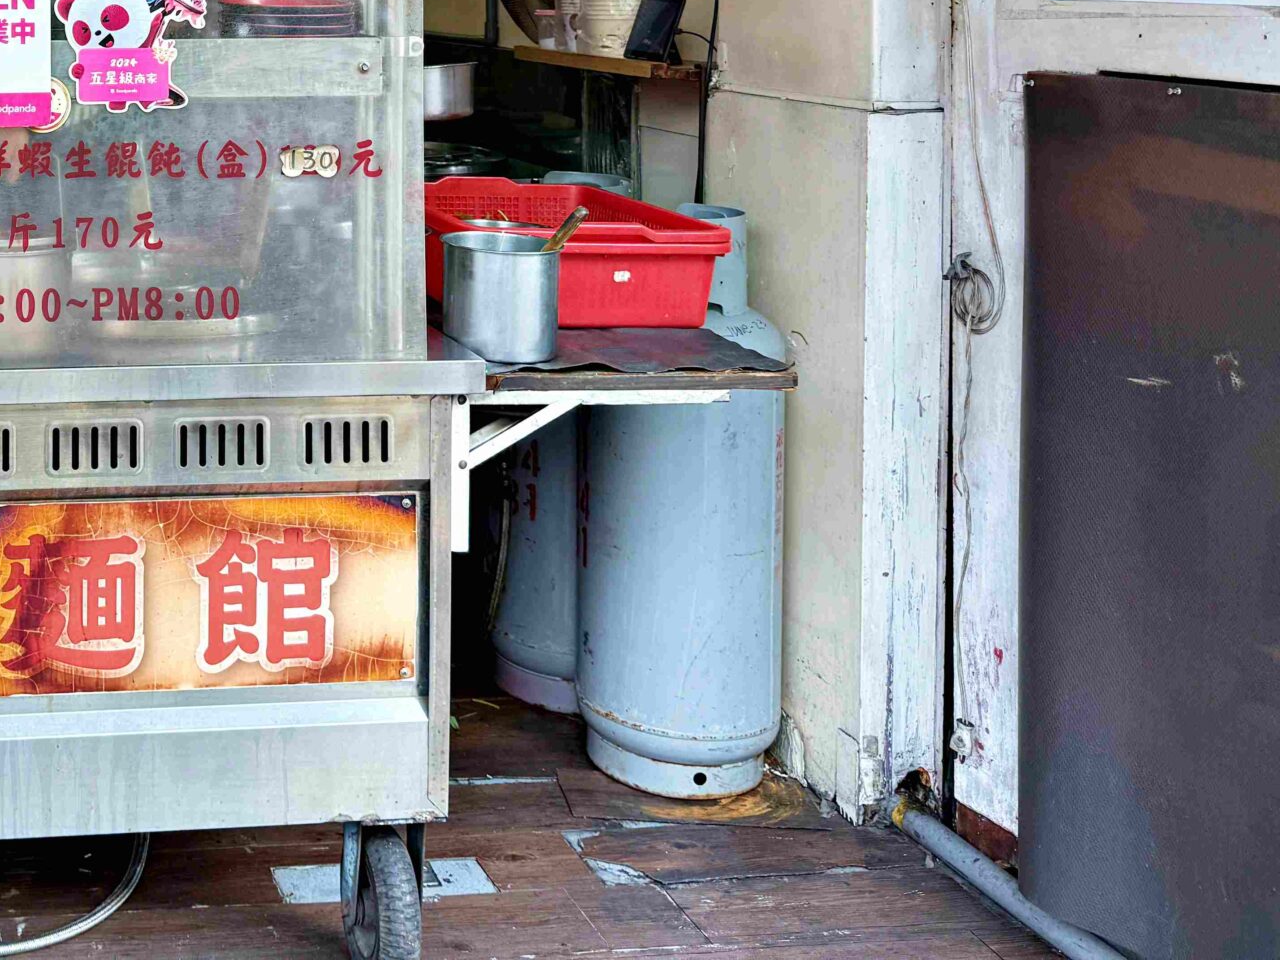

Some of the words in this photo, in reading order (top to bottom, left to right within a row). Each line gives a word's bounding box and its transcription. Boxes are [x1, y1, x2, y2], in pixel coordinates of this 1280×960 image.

[110, 57, 138, 68] 2024
[89, 71, 158, 86] 五星級商家
[287, 149, 334, 172] 130
[349, 139, 383, 178] 元
